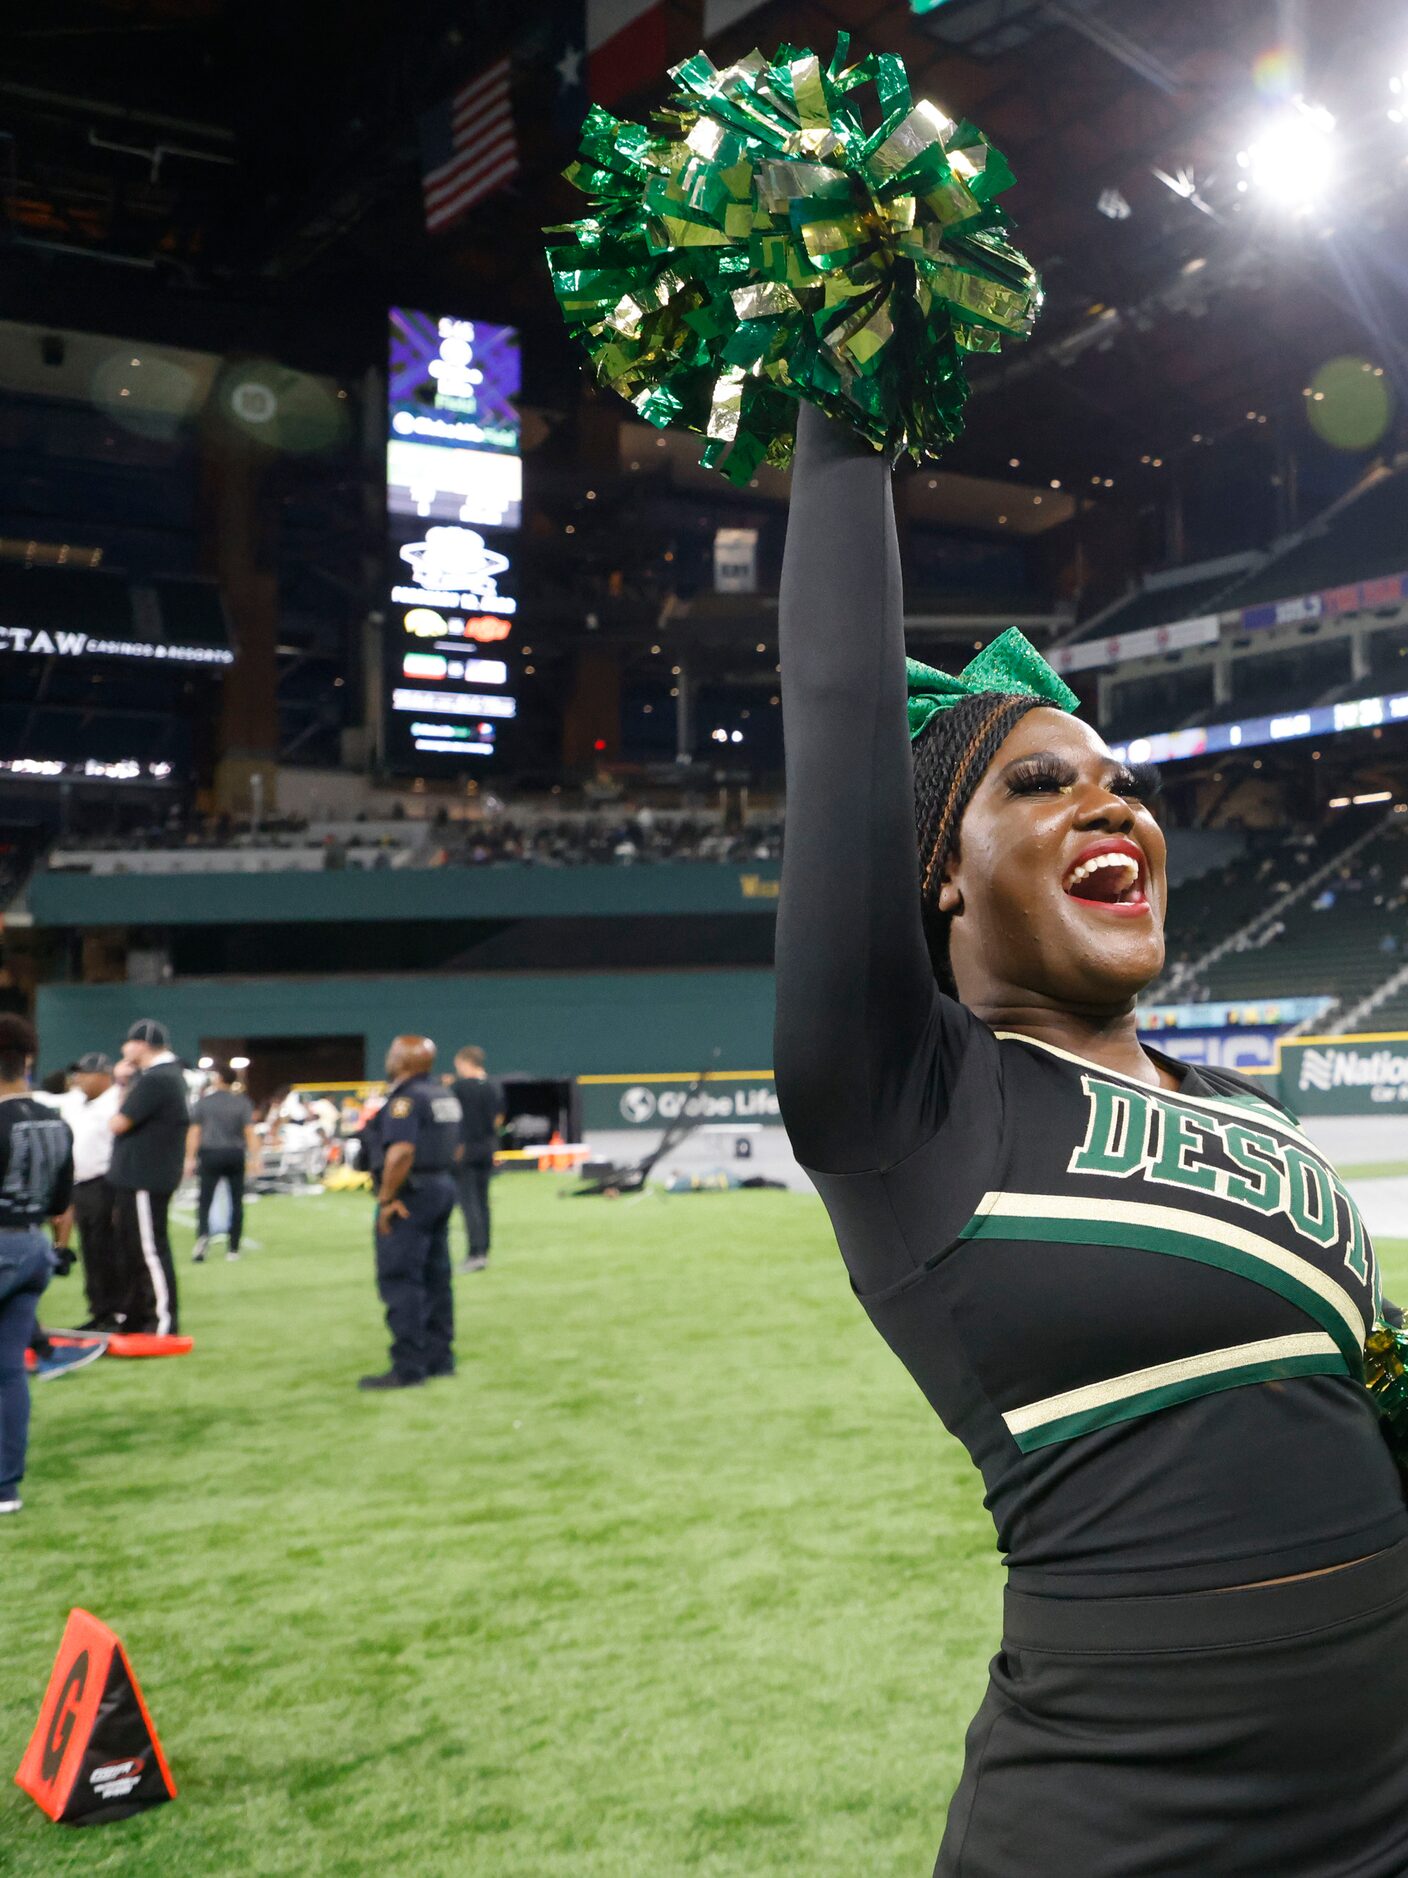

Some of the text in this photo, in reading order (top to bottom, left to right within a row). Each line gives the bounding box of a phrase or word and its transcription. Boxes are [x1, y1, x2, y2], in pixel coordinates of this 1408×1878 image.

[657, 1087, 780, 1118] Globe Life
[1067, 1074, 1383, 1300] DESOT
[41, 1648, 90, 1787] G
